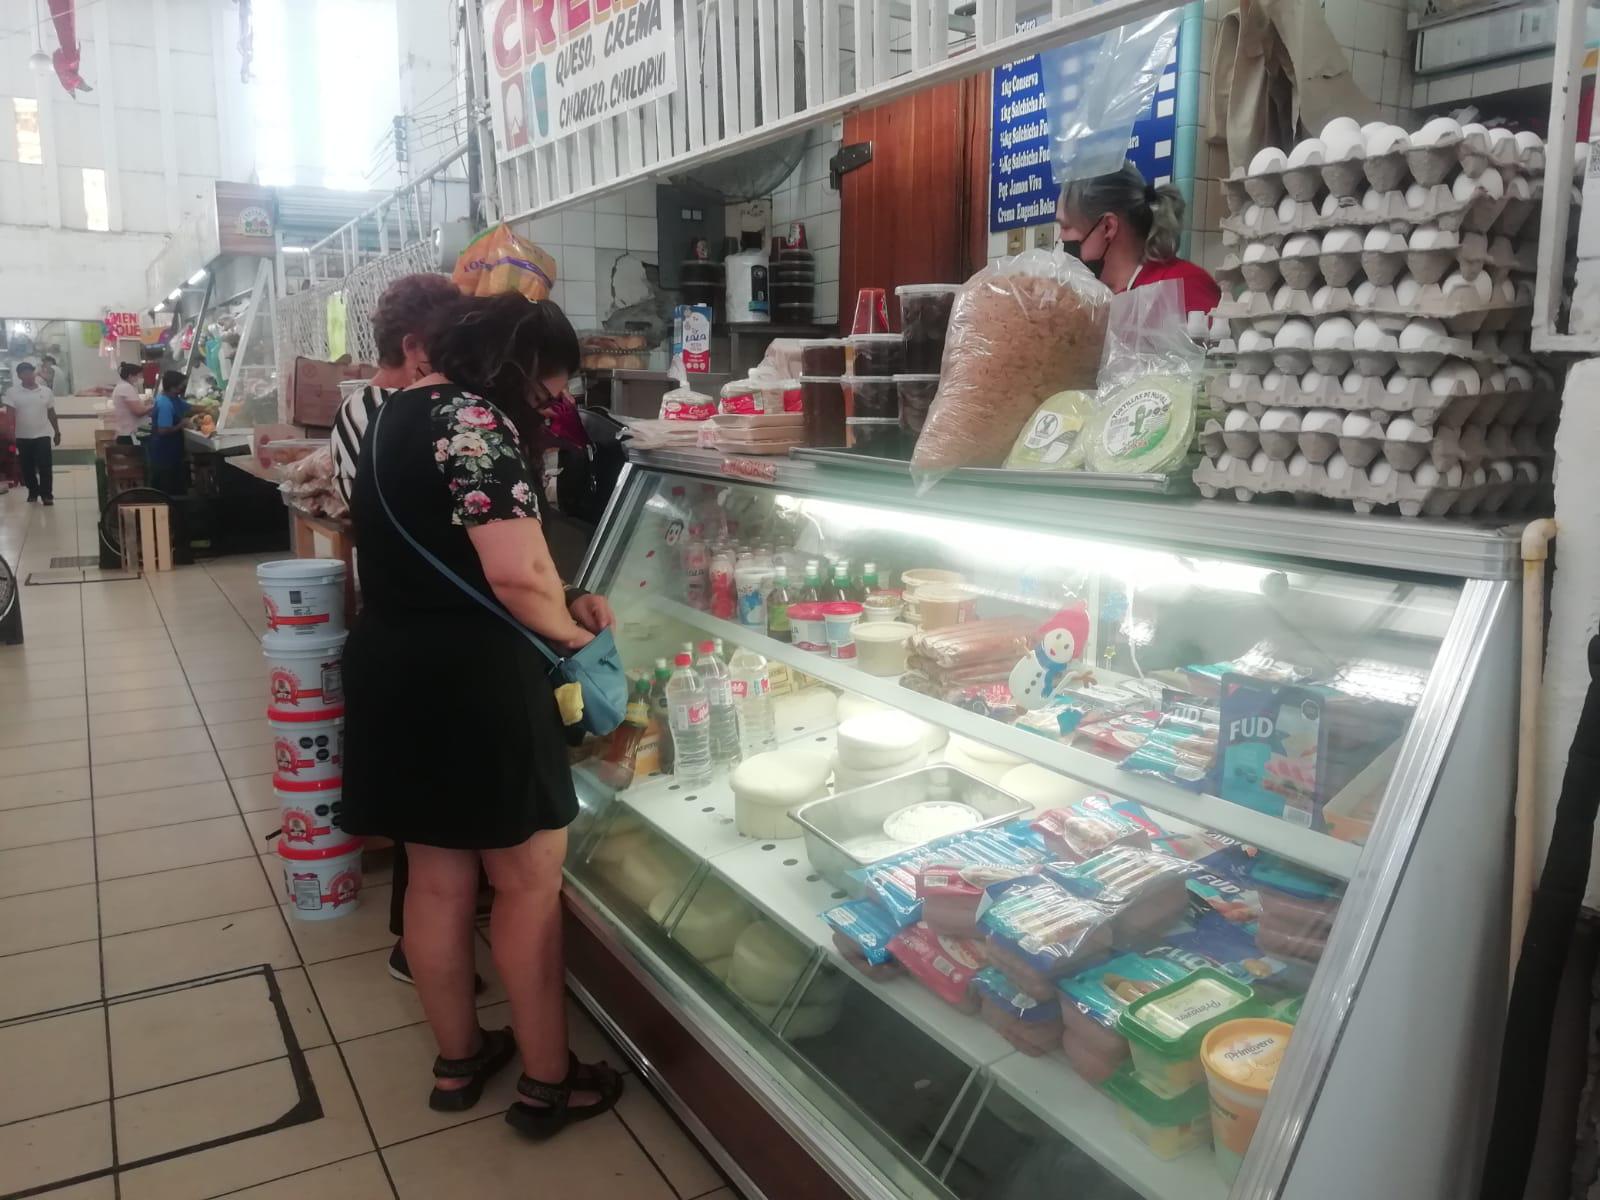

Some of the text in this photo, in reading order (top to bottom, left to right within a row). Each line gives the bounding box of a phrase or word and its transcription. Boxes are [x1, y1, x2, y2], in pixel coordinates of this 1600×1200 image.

[556, 0, 662, 88] QUESO, CREMA
[1012, 72, 1039, 93] Conserva
[1012, 96, 1039, 118] Salchicha
[1013, 122, 1039, 144] Salchicha
[1012, 149, 1039, 169] Salchicha
[1010, 179, 1028, 196] Jamon
[998, 207, 1015, 223] Crema
[1040, 197, 1056, 216] Bolsa
[1229, 716, 1274, 741] FUD
[1197, 873, 1242, 895] FUD
[1223, 1037, 1276, 1062] Primavera
